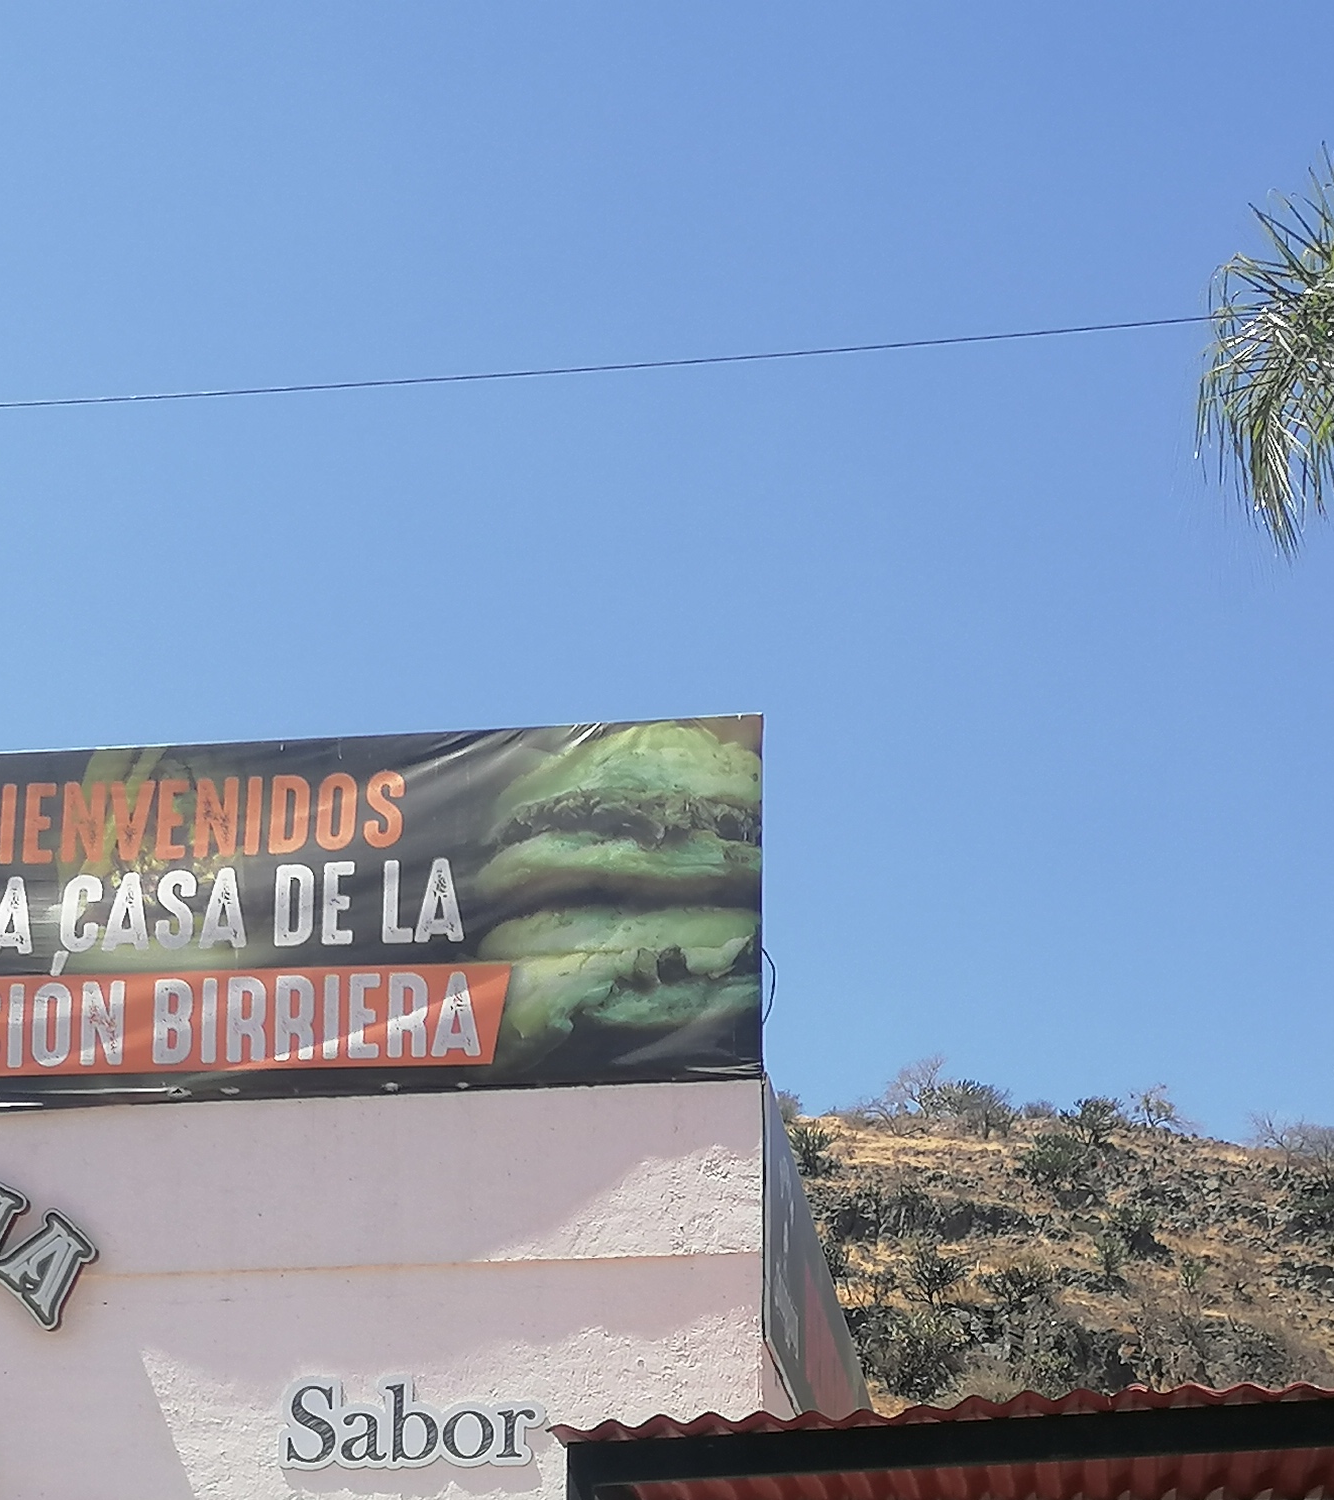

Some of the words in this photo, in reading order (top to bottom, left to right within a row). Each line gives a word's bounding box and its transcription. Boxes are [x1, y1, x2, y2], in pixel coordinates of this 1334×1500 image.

[63, 868, 249, 953] CASA
[273, 861, 356, 948] DE
[381, 857, 466, 944] LA
[152, 971, 482, 1067] BIRRIERA
[286, 1382, 537, 1464] Sabor
